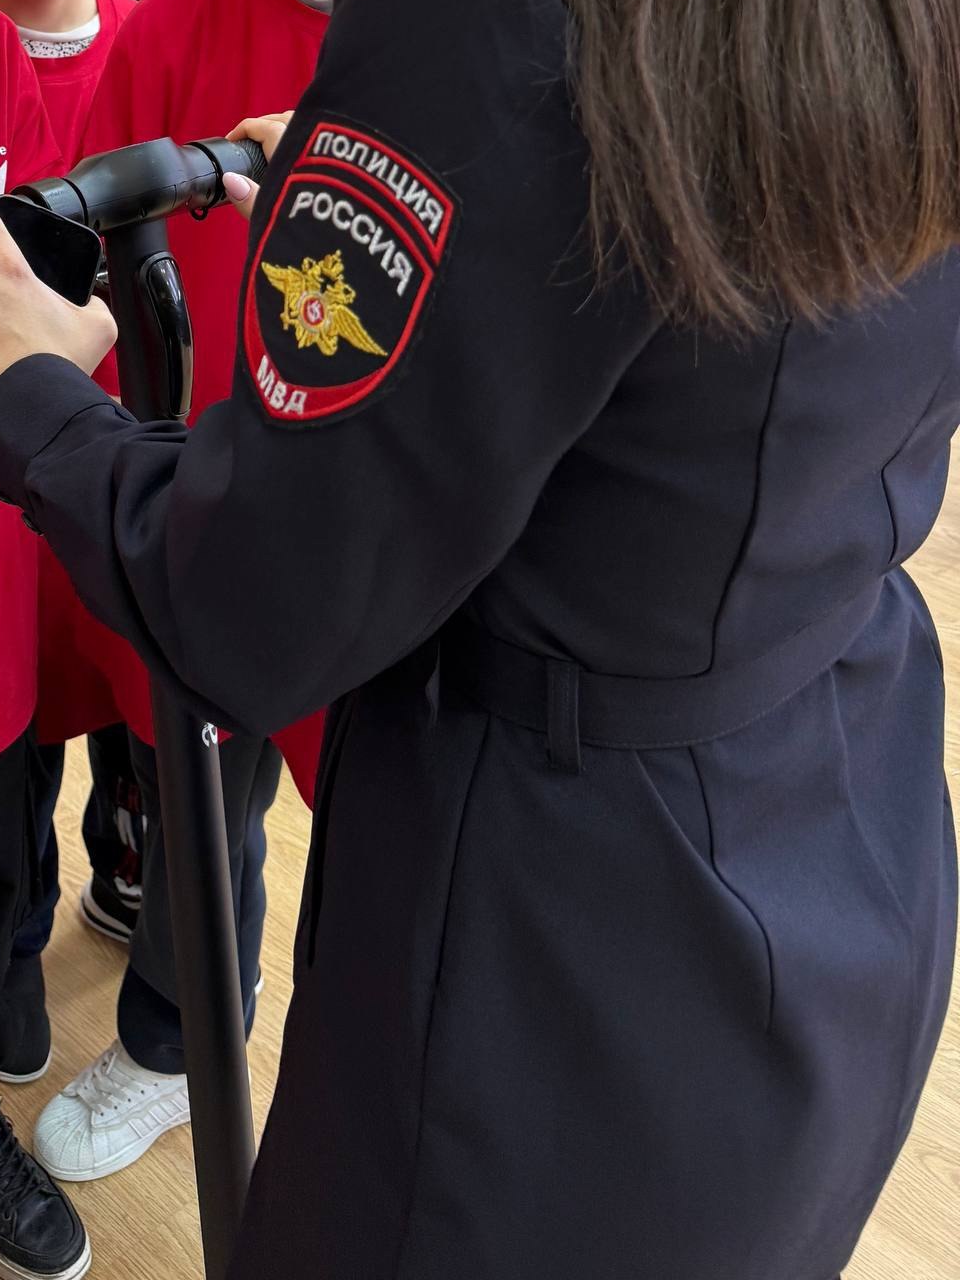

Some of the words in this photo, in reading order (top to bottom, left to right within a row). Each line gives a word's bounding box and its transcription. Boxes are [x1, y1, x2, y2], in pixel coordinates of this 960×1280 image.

[313, 132, 444, 234] ПОЛИЦИЯ
[289, 191, 413, 297] РОССИЯ
[256, 355, 308, 415] МВД
